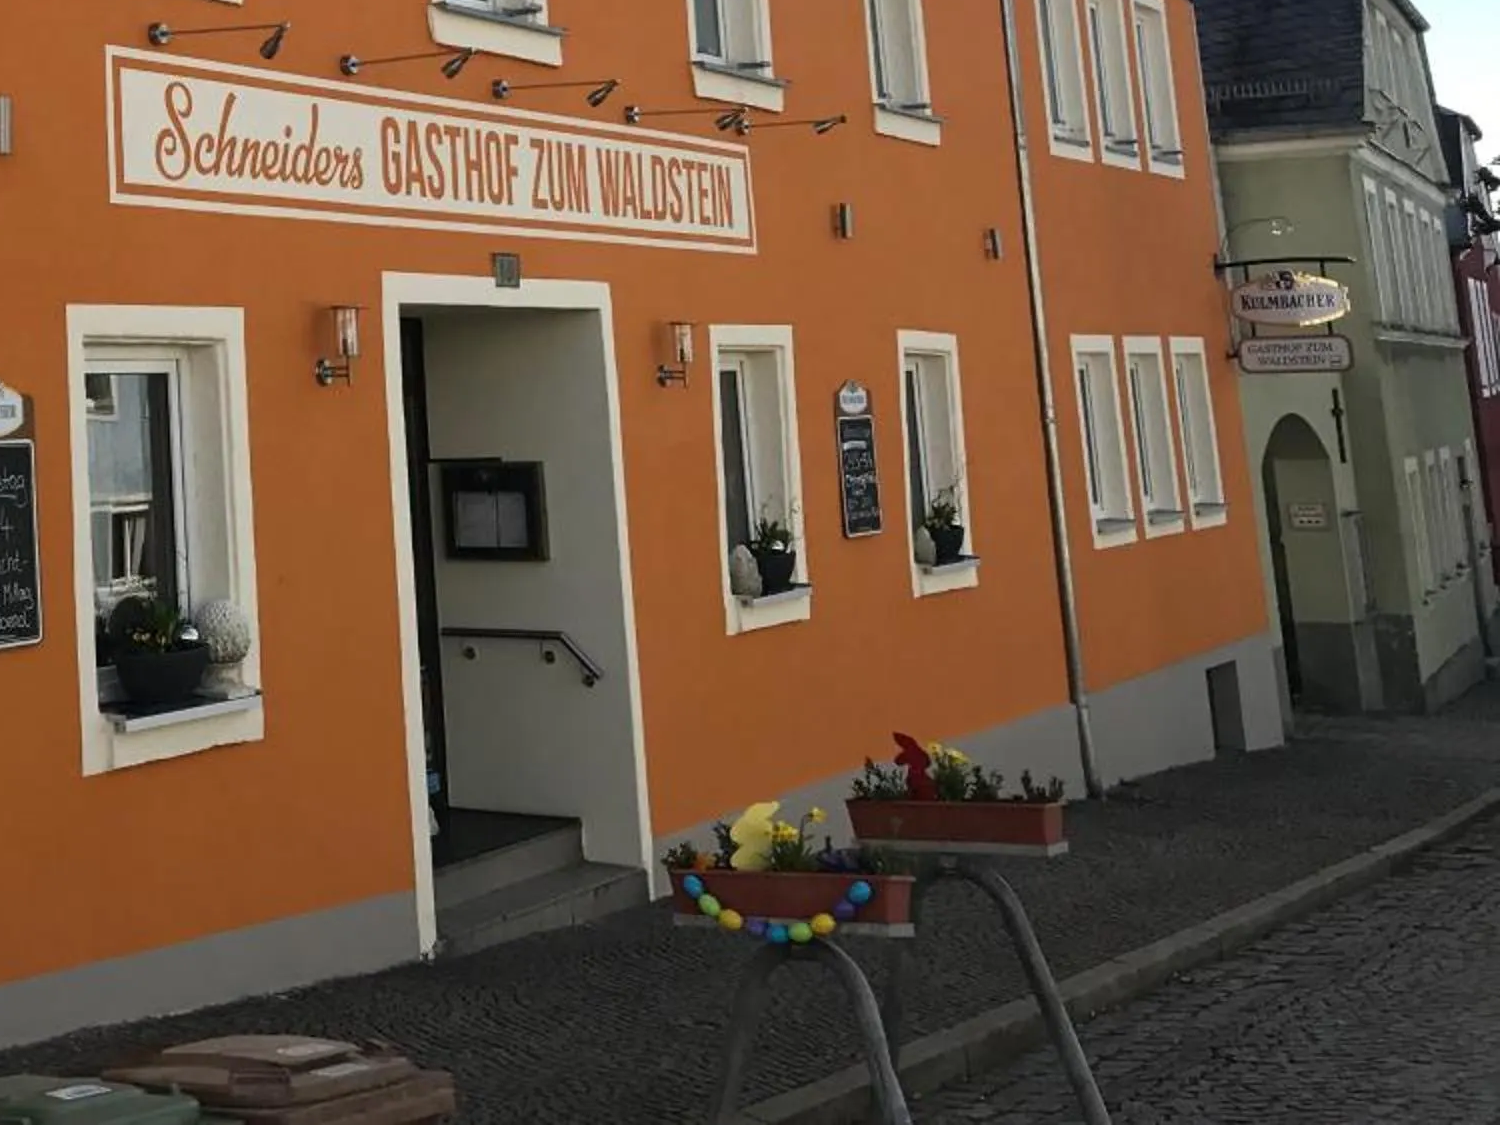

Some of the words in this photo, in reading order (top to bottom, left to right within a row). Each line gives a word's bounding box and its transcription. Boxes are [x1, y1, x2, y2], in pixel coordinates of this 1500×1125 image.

[155, 81, 363, 189] Schneiders
[379, 116, 519, 205] GASTHOF
[529, 136, 590, 215] ZUM
[595, 145, 733, 228] WALDSTEIN
[1240, 294, 1336, 310] KULMBACHER
[1248, 342, 1302, 354] GASTHOF
[1307, 341, 1333, 353] ZUM
